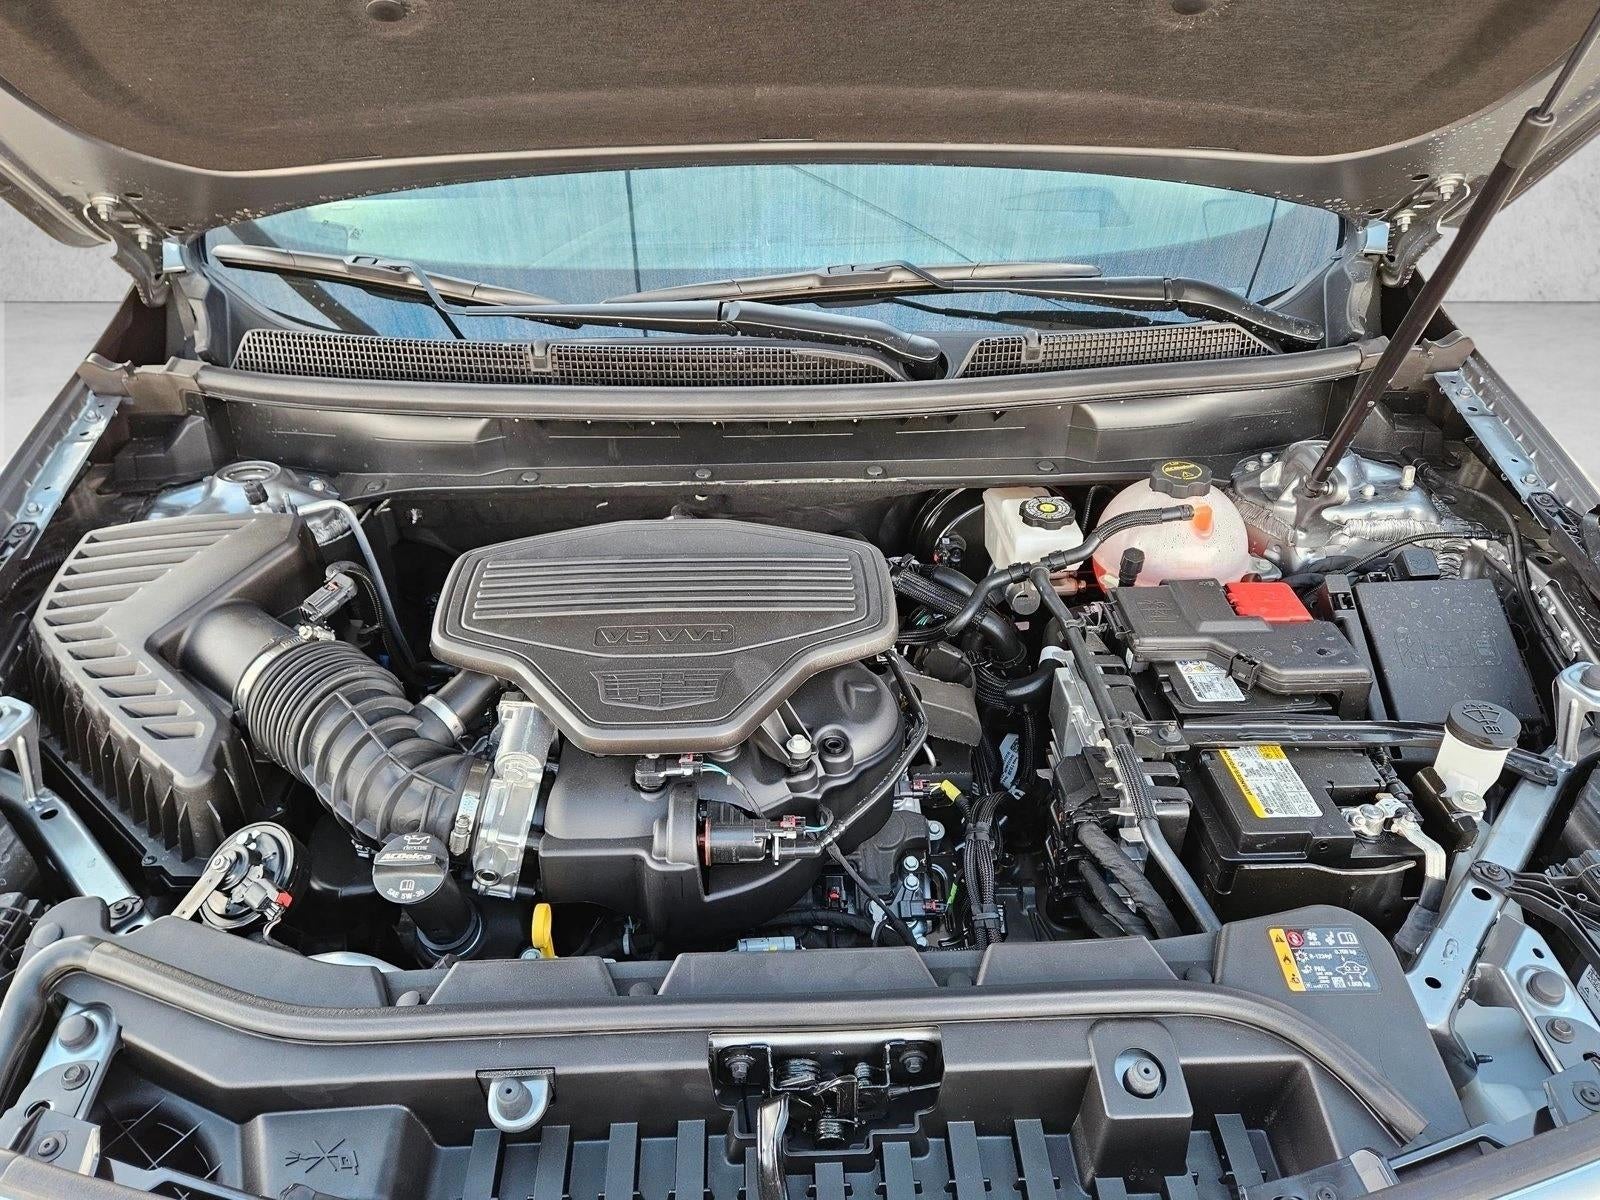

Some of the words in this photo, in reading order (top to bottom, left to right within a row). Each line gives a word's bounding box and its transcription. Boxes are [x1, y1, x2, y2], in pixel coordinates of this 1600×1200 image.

[600, 628, 649, 644] V6
[656, 627, 729, 642] VVT
[386, 888, 400, 899] SAE
